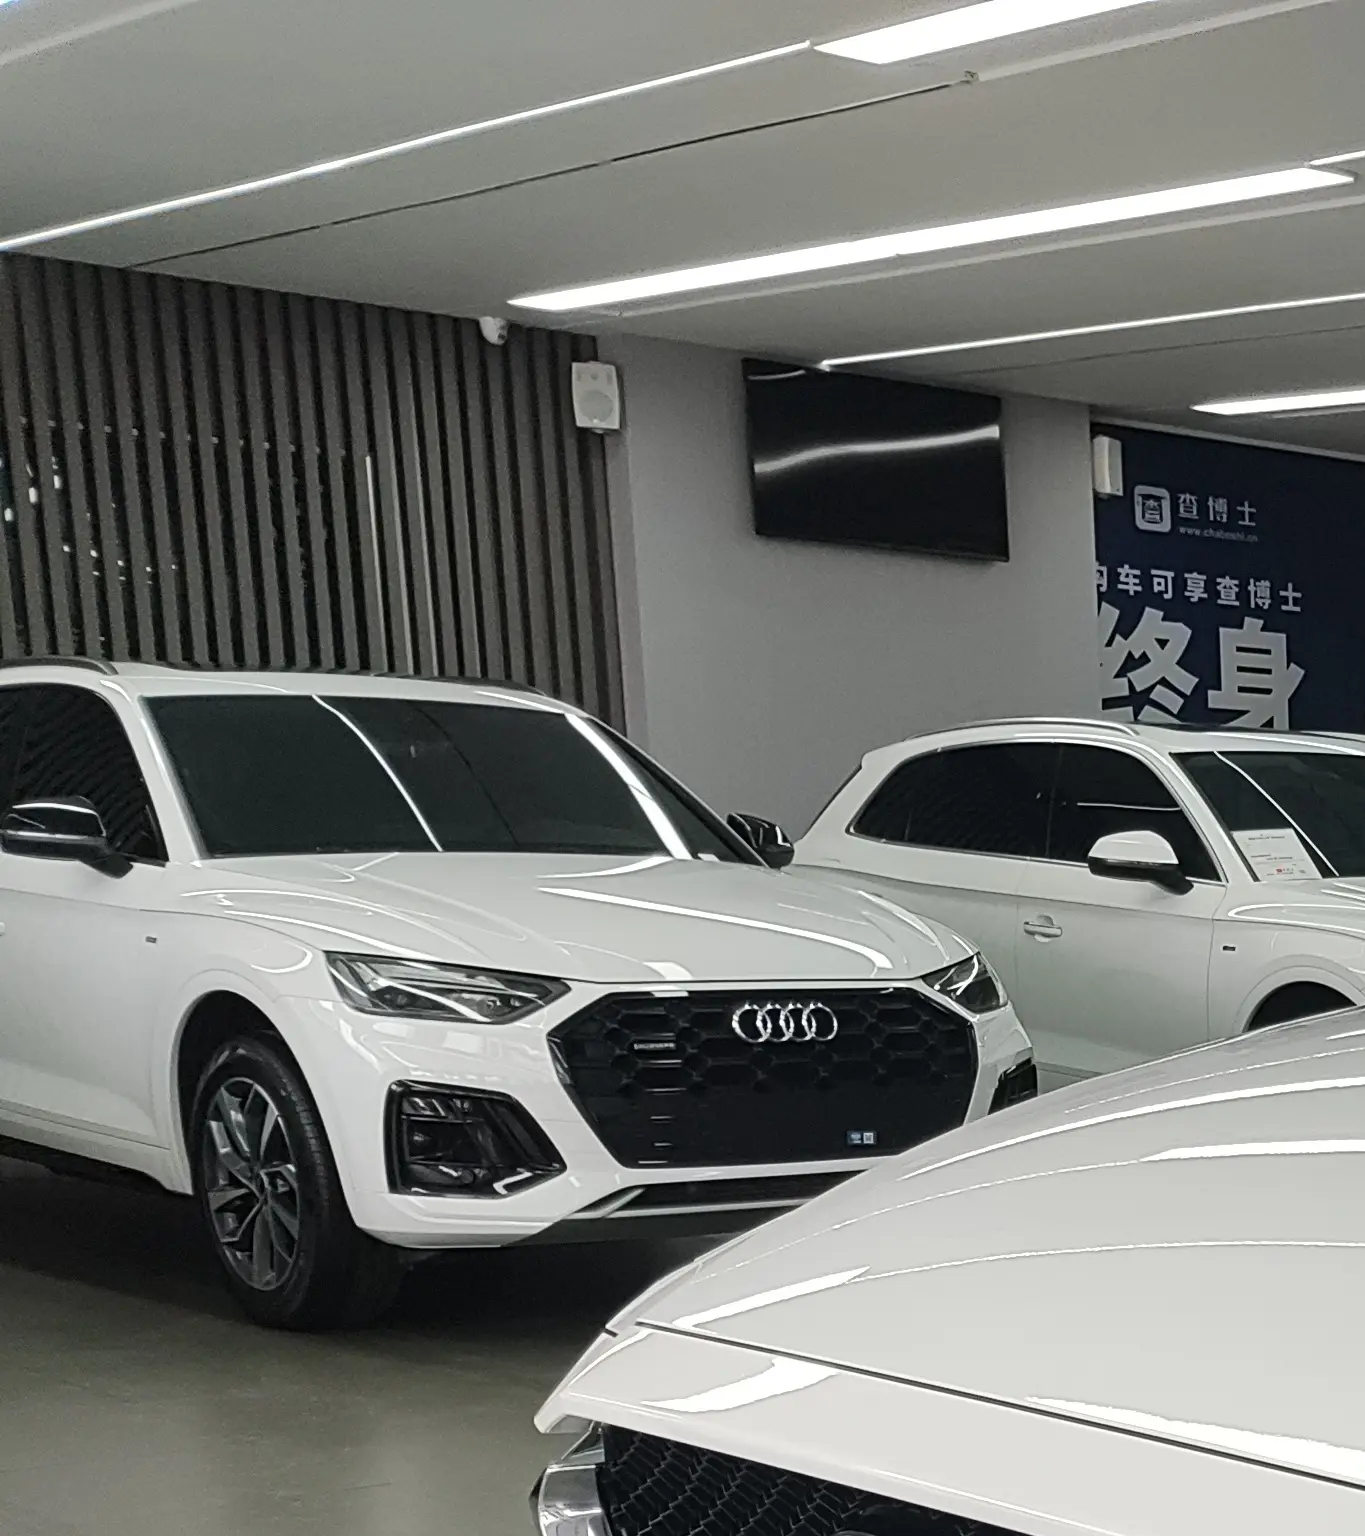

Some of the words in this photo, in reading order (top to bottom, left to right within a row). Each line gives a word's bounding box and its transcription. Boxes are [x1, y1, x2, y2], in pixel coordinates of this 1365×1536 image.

[1177, 493, 1257, 526] 查博士
[1098, 601, 1305, 731] 终身
